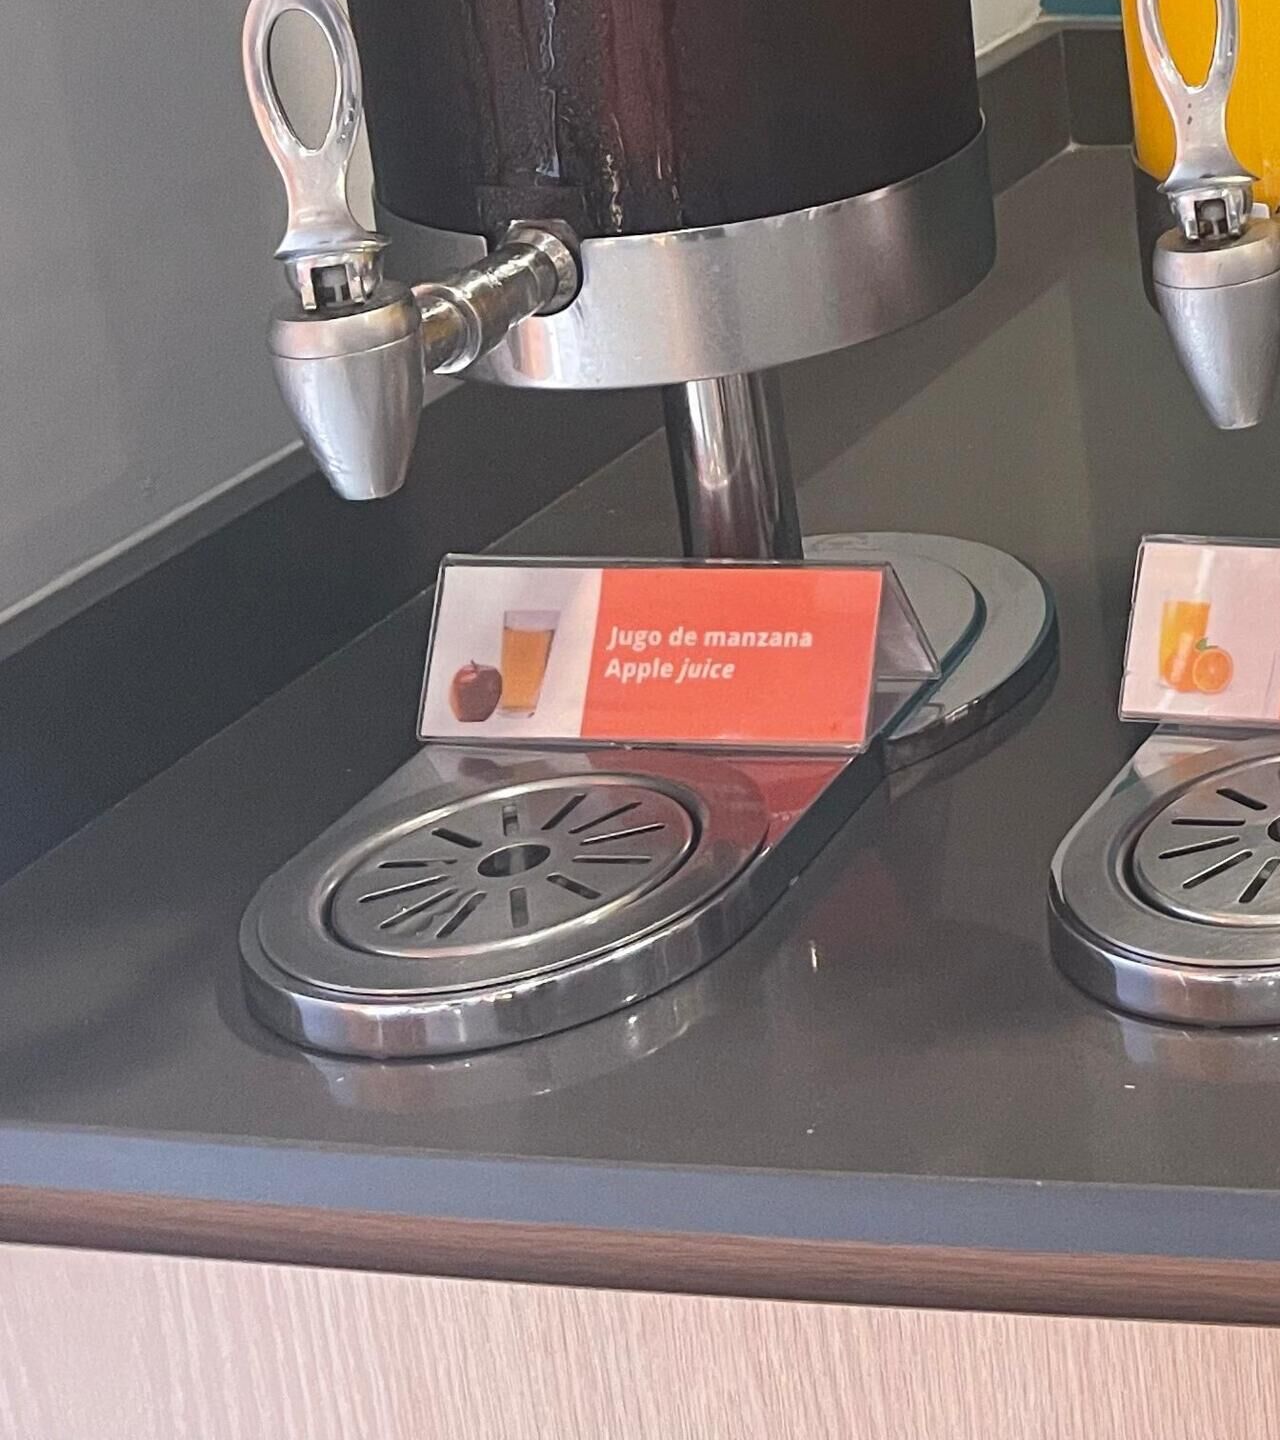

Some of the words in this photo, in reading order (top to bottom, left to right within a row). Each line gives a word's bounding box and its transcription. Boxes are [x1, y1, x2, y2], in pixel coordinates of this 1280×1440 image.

[605, 626, 662, 652] Jugo
[668, 626, 697, 646] de
[703, 630, 813, 647] manzana
[604, 658, 674, 684] Apple
[675, 658, 736, 684] juice
